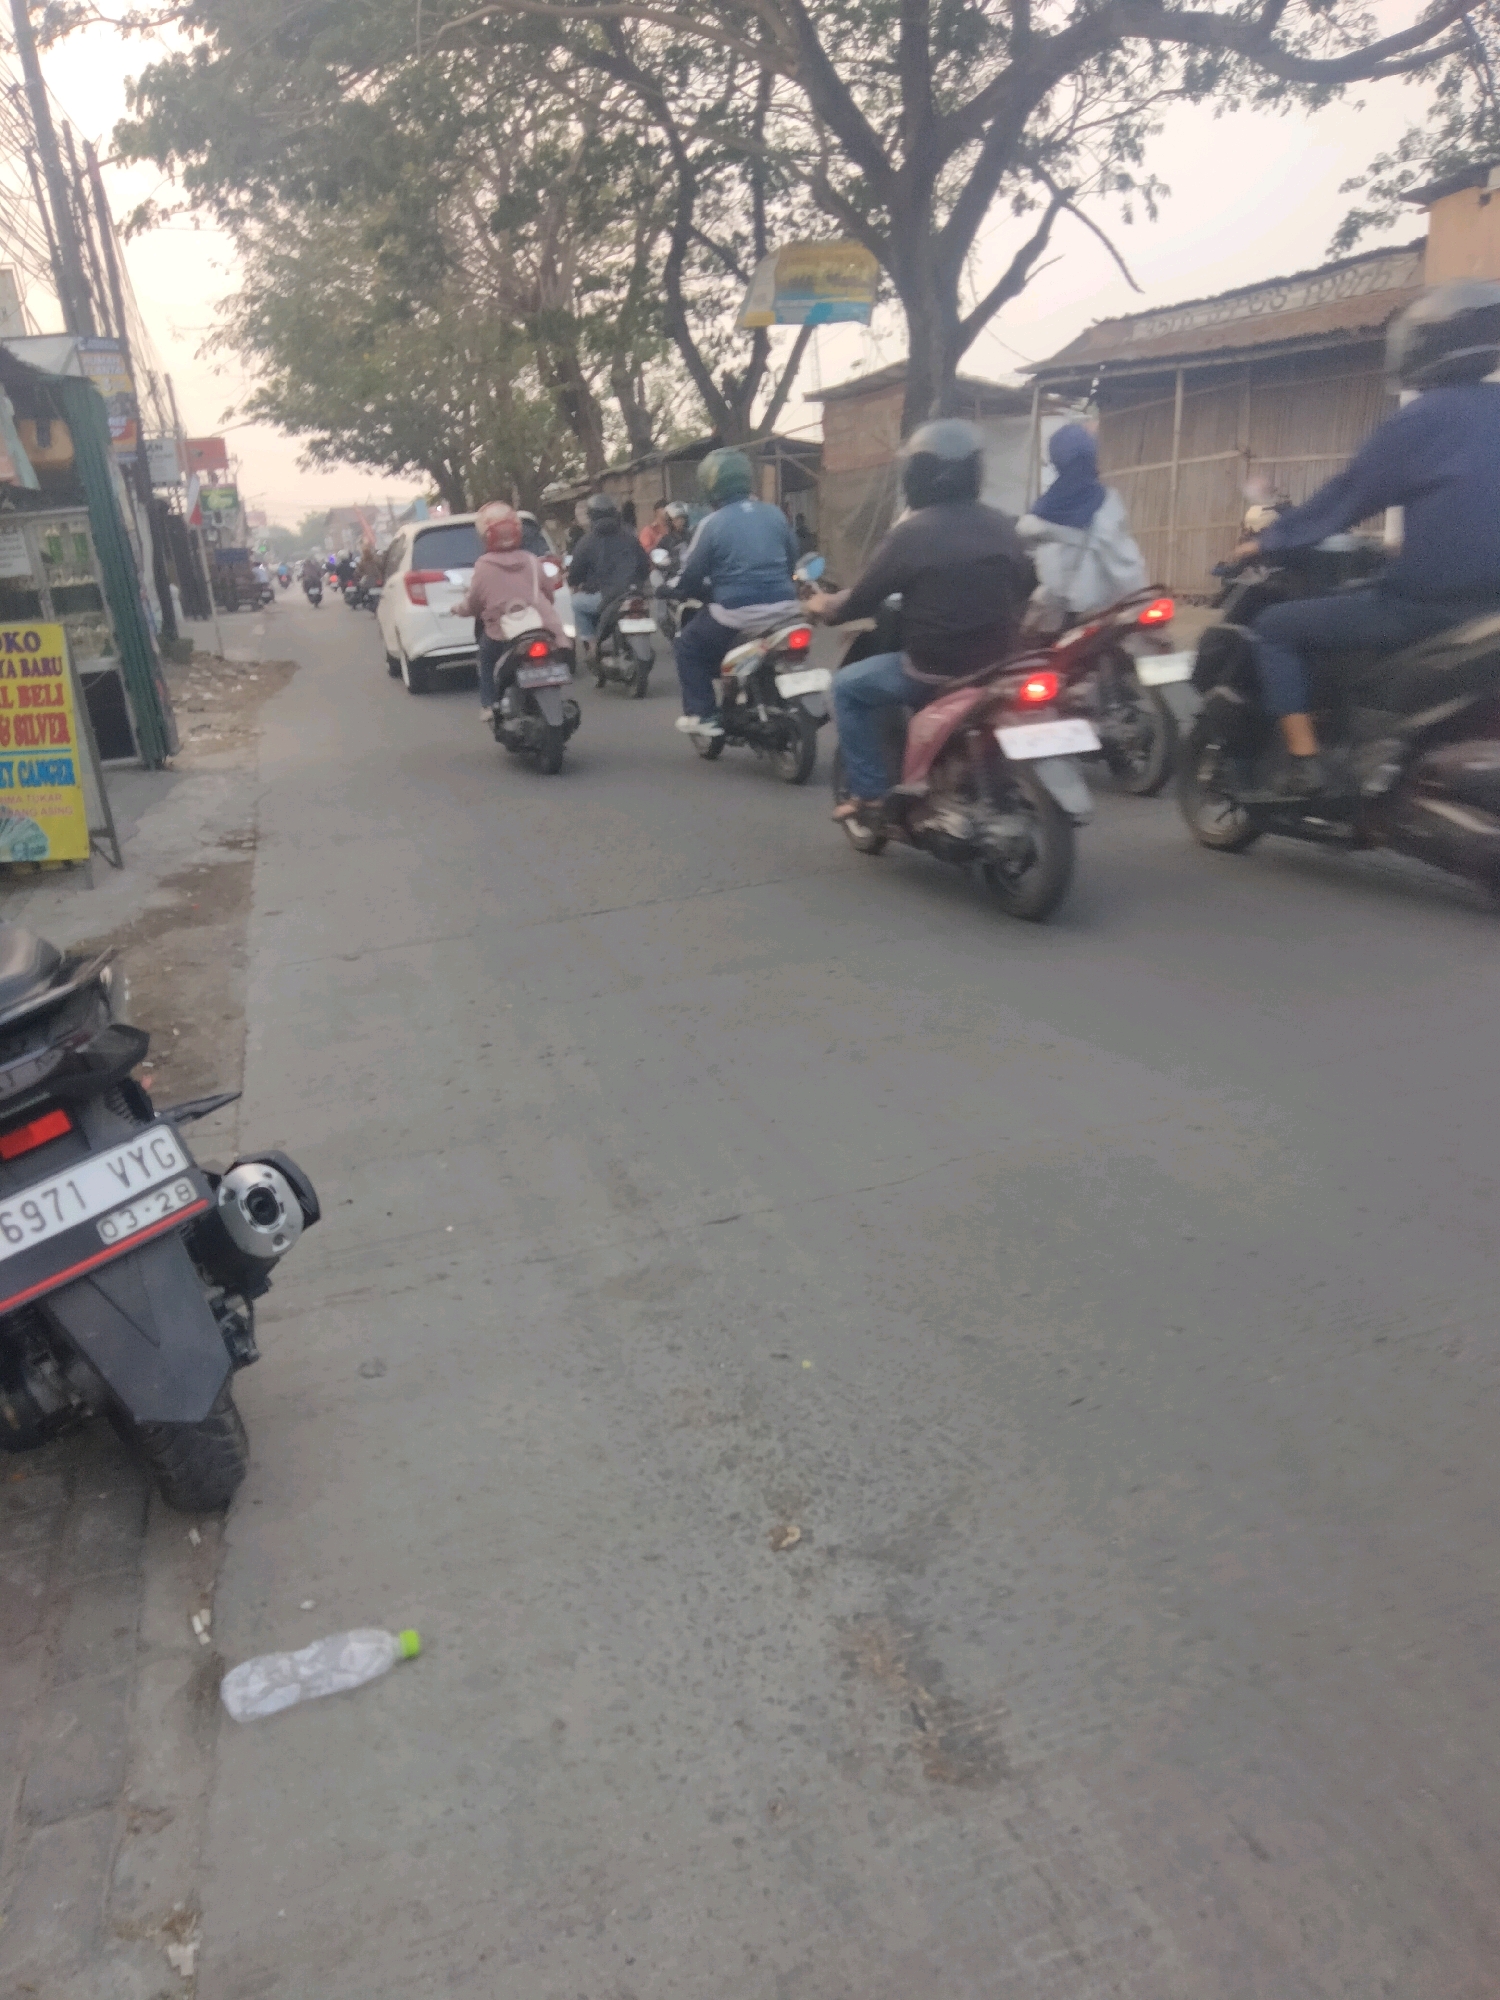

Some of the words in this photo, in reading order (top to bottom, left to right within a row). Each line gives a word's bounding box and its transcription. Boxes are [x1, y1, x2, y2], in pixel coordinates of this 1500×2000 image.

[0, 631, 41, 653] KO
[17, 683, 64, 708] BELI
[13, 712, 71, 747] SILVER
[0, 1180, 87, 1244] 6971
[105, 1137, 177, 1189] VYG
